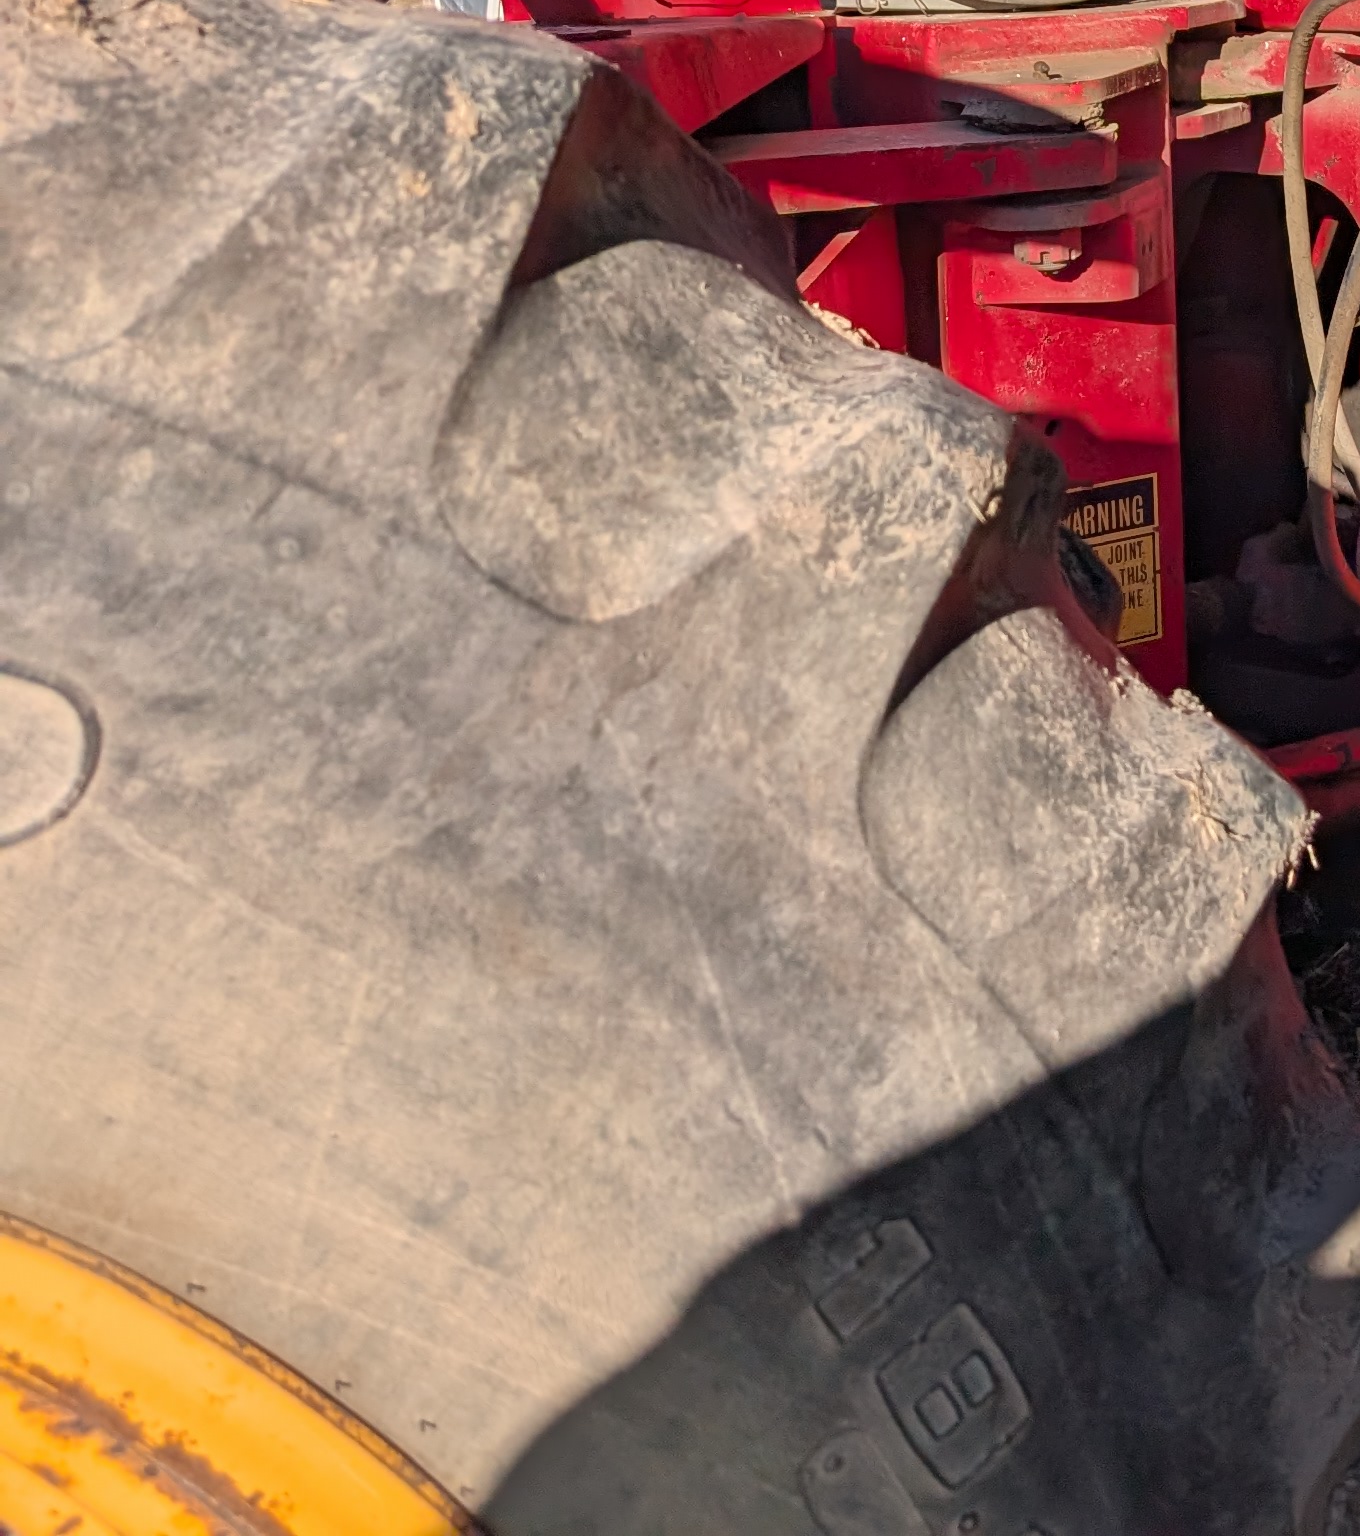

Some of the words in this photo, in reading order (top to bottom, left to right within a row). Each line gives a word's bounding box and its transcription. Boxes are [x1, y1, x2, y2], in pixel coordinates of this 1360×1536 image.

[1064, 495, 1144, 537] ARNING
[1107, 540, 1144, 565] JOINT
[1119, 563, 1148, 586] THIS
